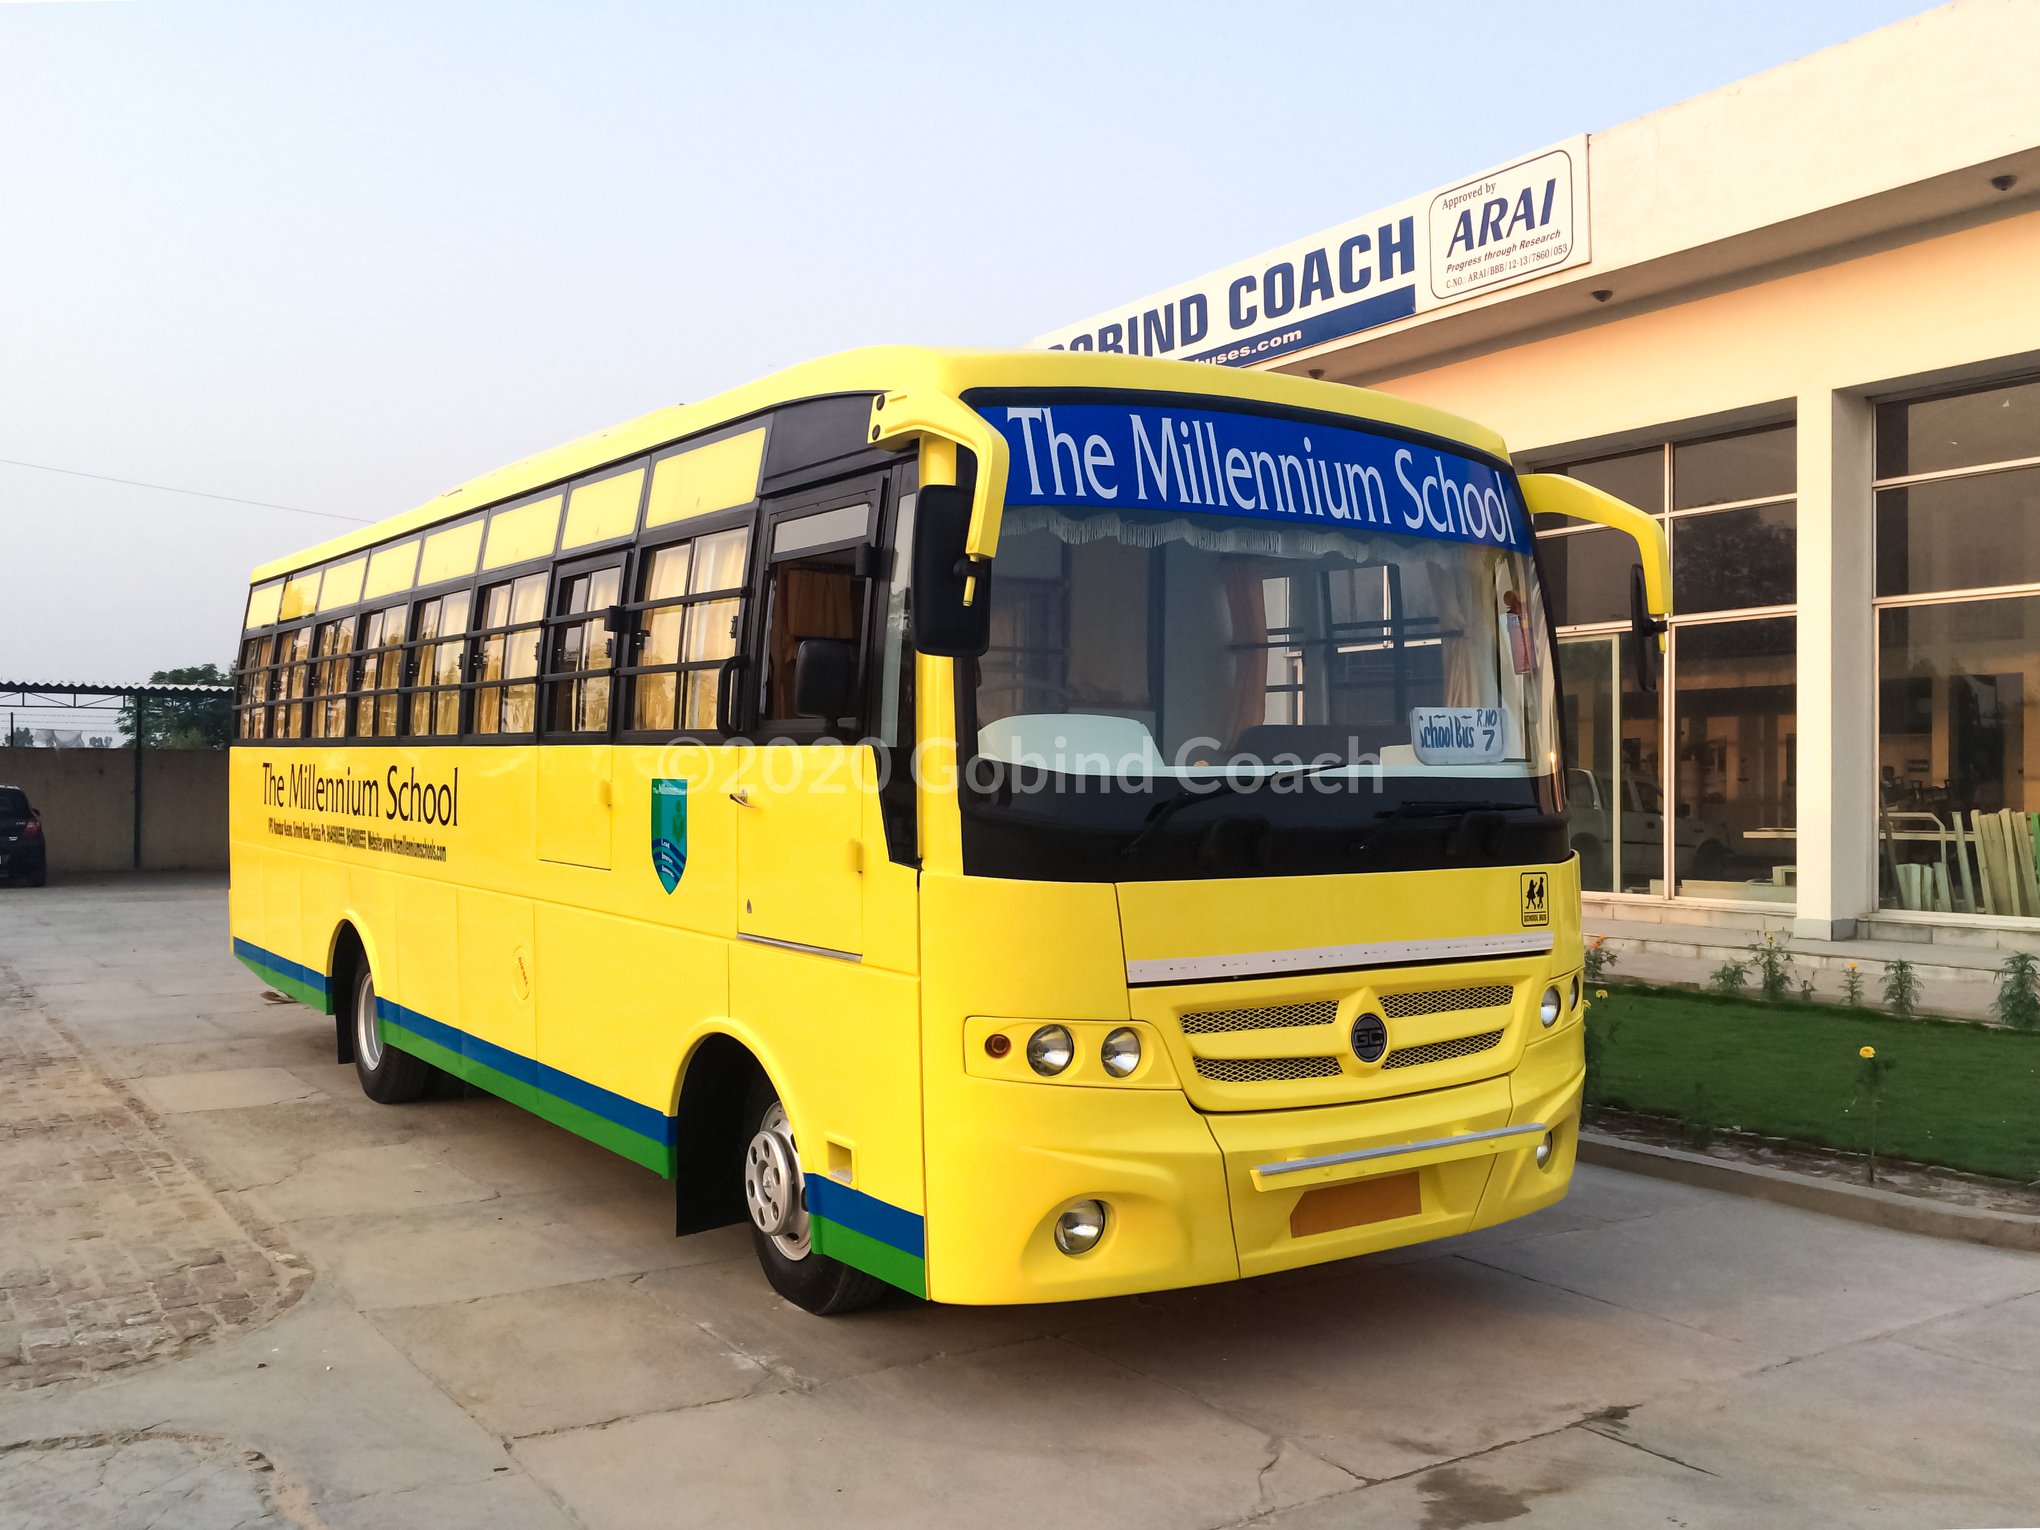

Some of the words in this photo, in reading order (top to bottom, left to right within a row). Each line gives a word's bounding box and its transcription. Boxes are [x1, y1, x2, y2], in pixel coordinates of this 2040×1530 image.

[1442, 185, 1482, 210] Approved
[1485, 182, 1496, 196] by
[1447, 178, 1556, 258] ARAI
[1446, 256, 1482, 274] Progress
[1484, 243, 1517, 261] through
[1519, 229, 1561, 250] Research
[1048, 293, 1208, 357] BIND
[1228, 215, 1415, 331] COACH
[1007, 407, 1118, 499] The
[1129, 414, 1391, 525] Millennium
[1394, 448, 1516, 545] School
[1454, 715, 1475, 748] Bus
[1482, 729, 1495, 752] 7
[263, 762, 284, 807] The
[289, 763, 379, 818] Millennium
[386, 765, 458, 827] School
